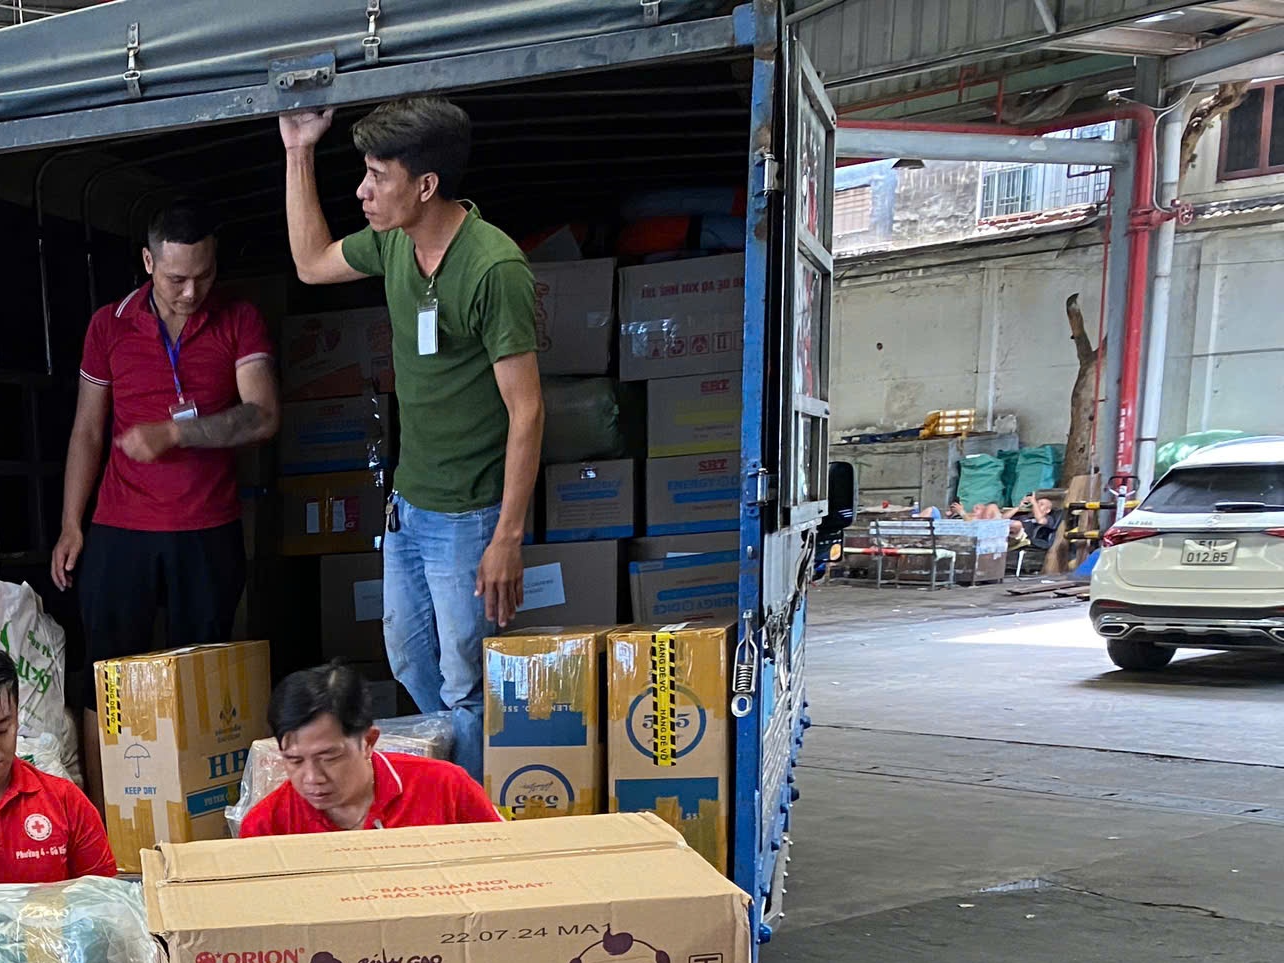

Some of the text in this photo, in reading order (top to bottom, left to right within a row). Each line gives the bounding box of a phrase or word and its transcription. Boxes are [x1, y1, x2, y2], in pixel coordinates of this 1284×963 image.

[1186, 552, 1228, 563] 012.85
[642, 713, 691, 728] 55
[124, 786, 142, 795] KEEP
[440, 923, 611, 944] 22.07.24 MA1
